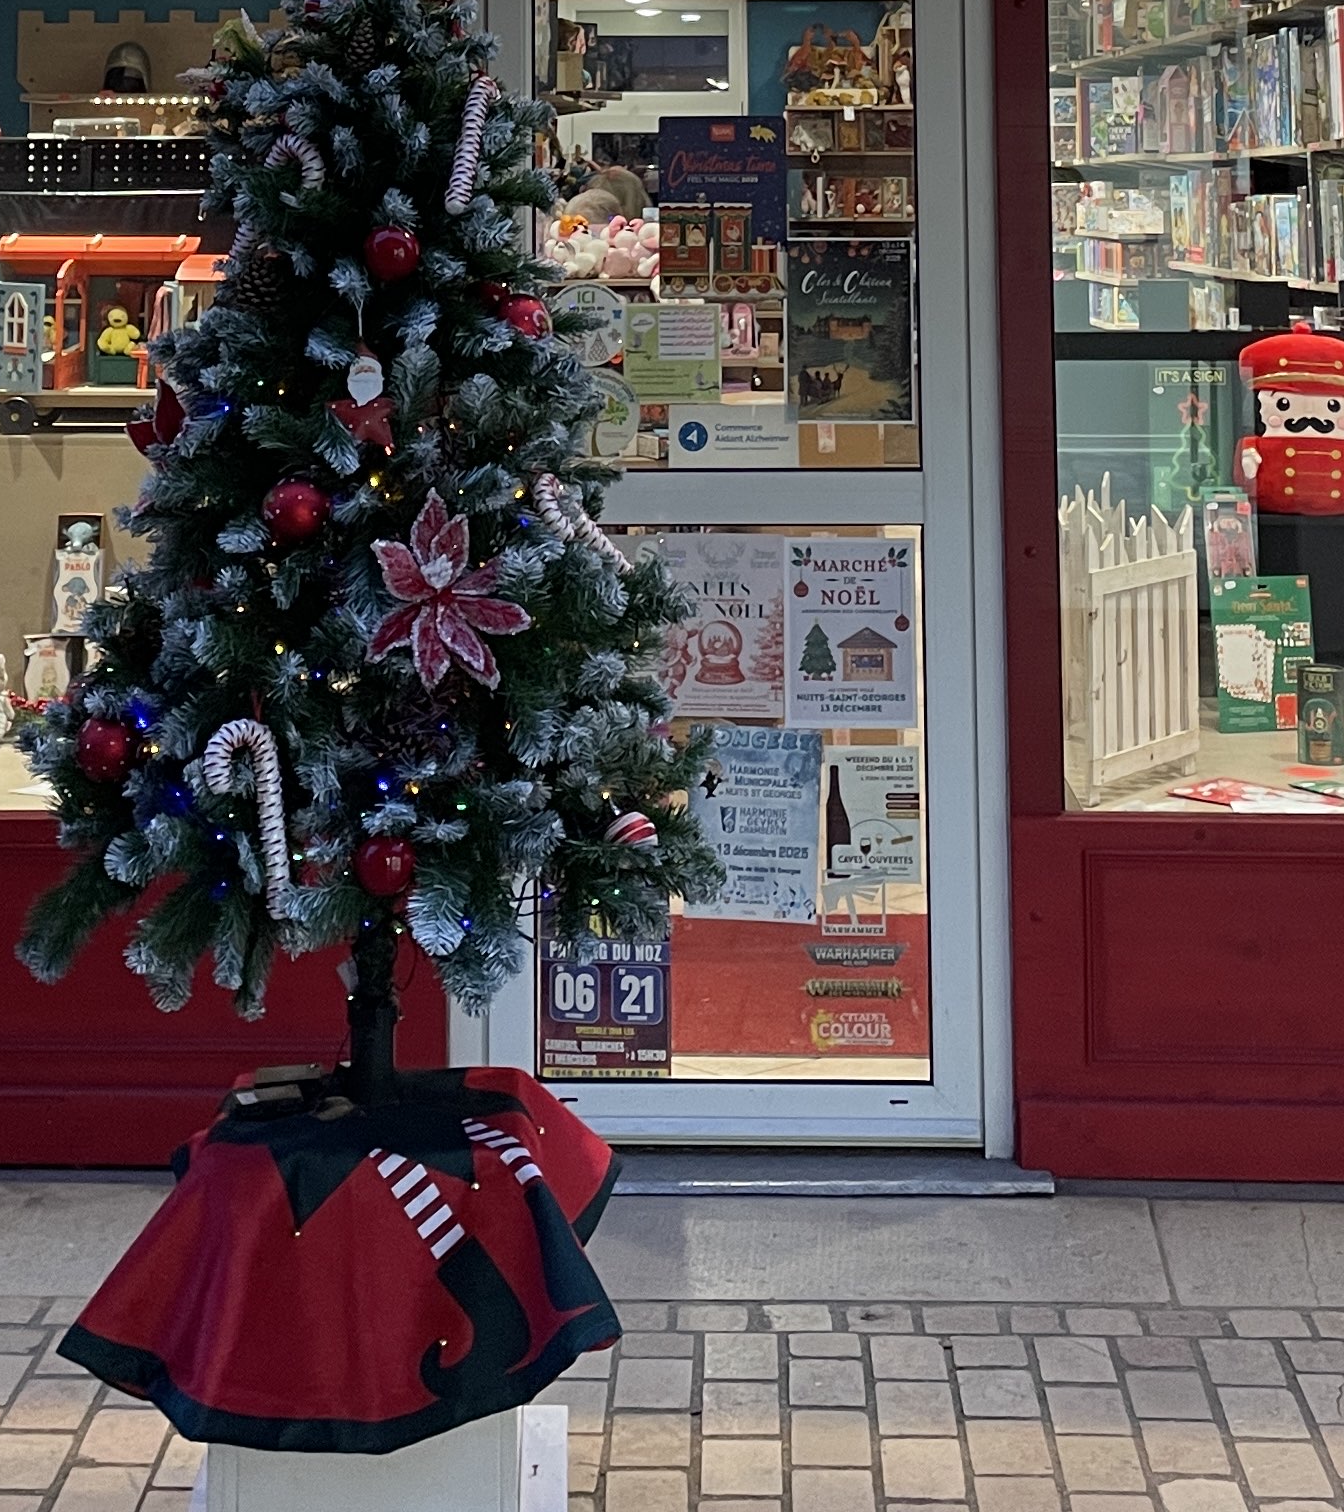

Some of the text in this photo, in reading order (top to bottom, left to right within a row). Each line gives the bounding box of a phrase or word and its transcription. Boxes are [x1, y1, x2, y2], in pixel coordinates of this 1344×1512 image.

[577, 291, 595, 304] ICI
[1158, 370, 1223, 382] IT'S A SIGN
[714, 423, 763, 432] Commerce
[745, 434, 790, 443] Alzheimer
[64, 561, 91, 572] PABLO
[813, 557, 888, 573] MARCHÉ
[843, 576, 856, 585] DE
[820, 585, 881, 606] NOËL
[821, 703, 882, 713] 13 DÉCEMBRE
[713, 726, 822, 751] ONCERT
[729, 765, 780, 776] HARMONIE
[734, 775, 789, 787] MUNICIPALE
[751, 789, 762, 798] ST
[763, 790, 802, 800] GEORGES
[739, 808, 788, 817] HARMONIE
[717, 843, 809, 859] 13 décembre 2025
[838, 855, 914, 865] CAVES OUVERTES
[824, 925, 885, 935] WARHAMMER
[612, 943, 631, 961] DU
[814, 947, 896, 961] WARHAMMER
[554, 972, 655, 1014] 06 21
[817, 1022, 892, 1039] COLOUR
